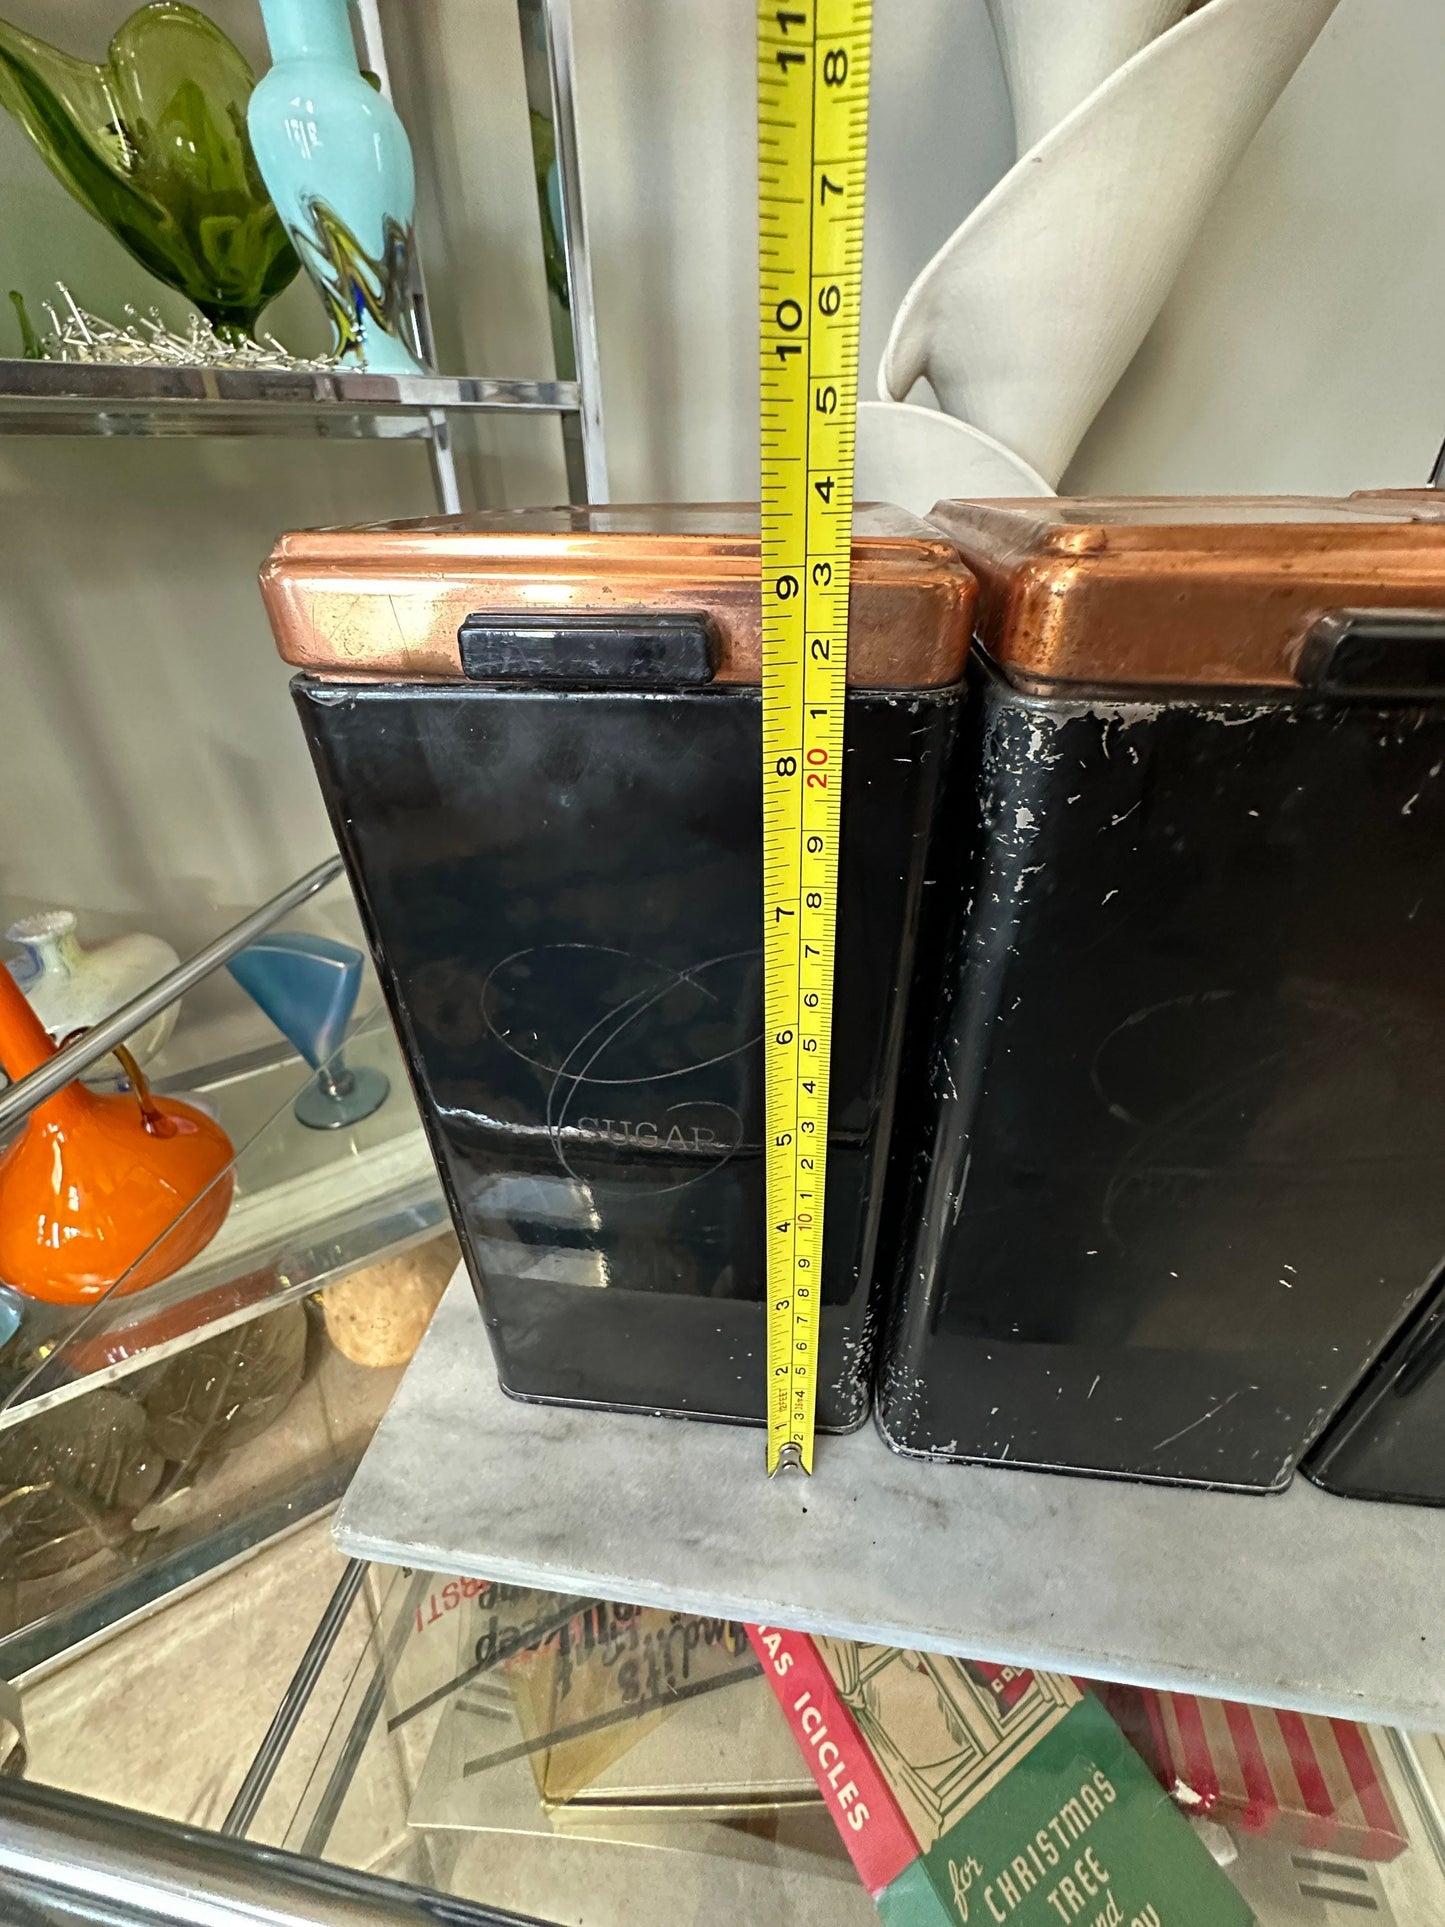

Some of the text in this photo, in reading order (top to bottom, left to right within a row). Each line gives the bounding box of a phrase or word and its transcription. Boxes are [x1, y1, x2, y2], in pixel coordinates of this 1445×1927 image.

[775, 11, 806, 73] 11
[823, 48, 848, 87] 8
[820, 174, 843, 206] 7
[819, 285, 841, 316] 6
[776, 299, 802, 362] 10
[816, 386, 837, 414] 5
[815, 476, 835, 504] 4
[812, 562, 832, 586] 3
[776, 575, 799, 600] 9
[811, 639, 830, 660] 2
[810, 709, 828, 719] 1
[776, 756, 796, 777] 8
[807, 748, 828, 788] 20
[807, 836, 823, 853] 9
[806, 893, 822, 908] 8
[776, 906, 794, 923] 7
[805, 945, 820, 958] 7
[804, 993, 819, 1007] 6
[776, 1030, 793, 1045] 6
[803, 1039, 817, 1052] 5
[802, 1081, 816, 1094] 4
[577, 1116, 720, 1152] SUGAR
[801, 1121, 815, 1133] 3
[775, 1133, 792, 1147] 5
[801, 1158, 813, 1170] 2
[776, 1221, 791, 1233] 4
[797, 1213, 812, 1231] 10
[798, 1258, 810, 1268] 9
[797, 1288, 809, 1297] 8
[776, 1299, 790, 1311] 3
[797, 1316, 808, 1324] 7
[796, 1342, 807, 1350] 6
[775, 1366, 788, 1376] 2
[795, 1367, 806, 1375] 5
[795, 1390, 805, 1398] 4
[758, 1625, 870, 1831] AS ICICLES
[948, 1770, 1117, 1923] for CHRISTMAS
[1046, 1846, 1109, 1925] TREE
[1089, 1888, 1124, 1927] nd
